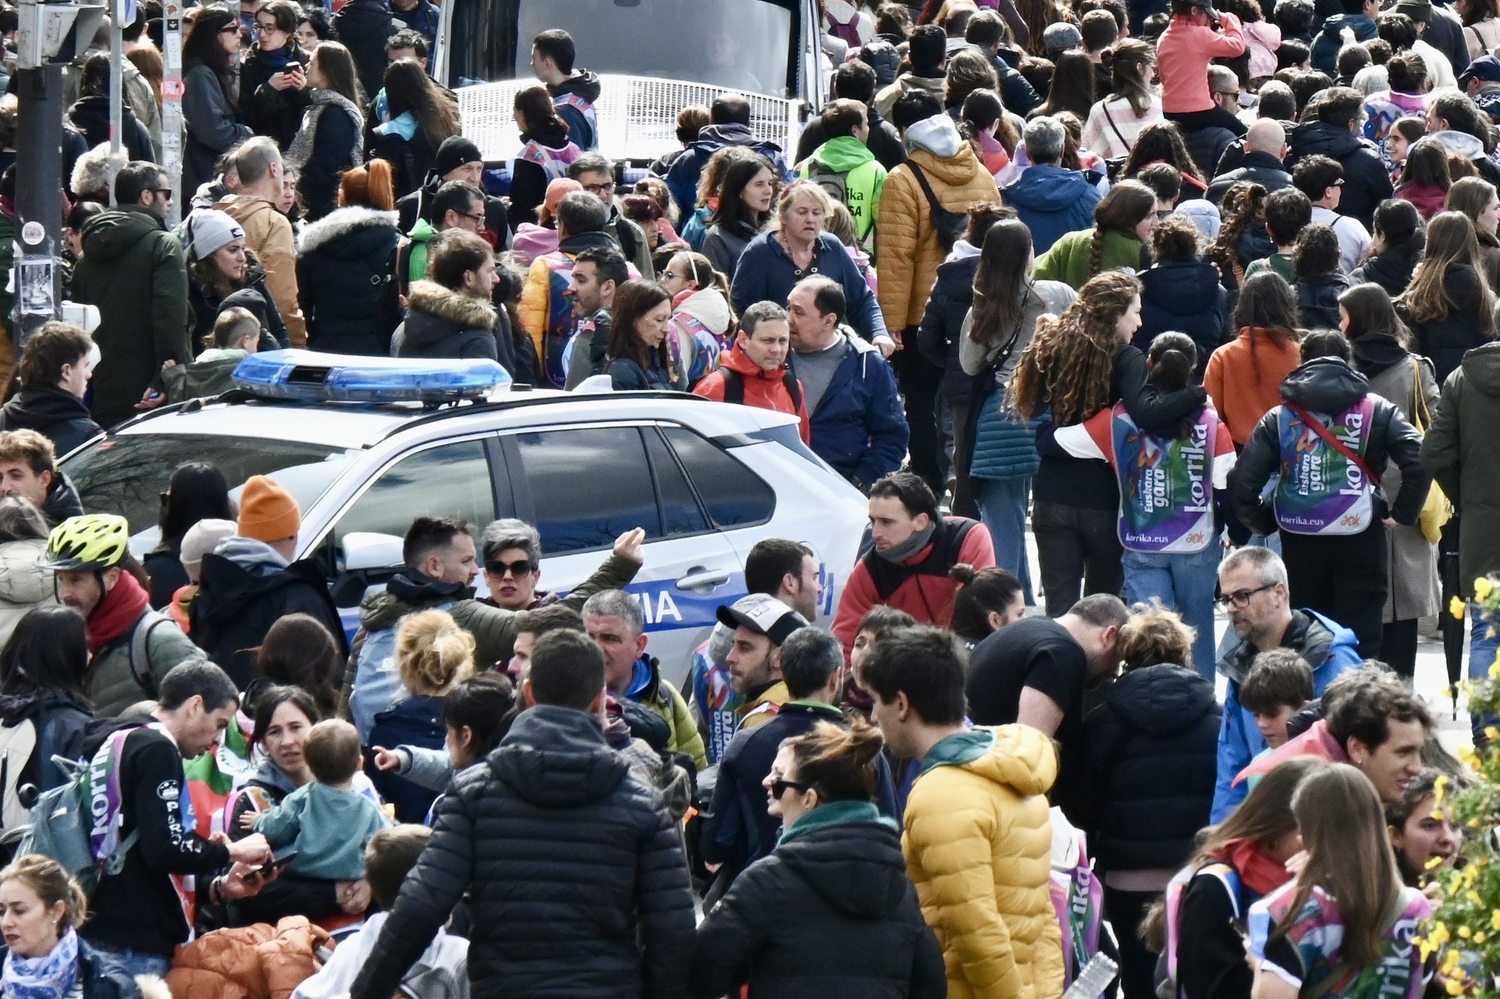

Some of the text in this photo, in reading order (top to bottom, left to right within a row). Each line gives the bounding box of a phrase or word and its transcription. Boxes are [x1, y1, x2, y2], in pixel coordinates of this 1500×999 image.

[1181, 423, 1208, 513] korrika
[1299, 453, 1311, 496] Euskara
[1310, 455, 1325, 491] gara
[1336, 413, 1364, 496] koika
[1144, 468, 1154, 513] Euskara
[1153, 468, 1169, 508] gara
[1125, 532, 1169, 543] korrika.eus
[1185, 532, 1205, 543] aek
[1280, 515, 1325, 527] korrika.eus
[1340, 514, 1362, 527] aek
[713, 710, 721, 763] uskara
[89, 740, 113, 837] korri
[1376, 919, 1419, 999] rika
